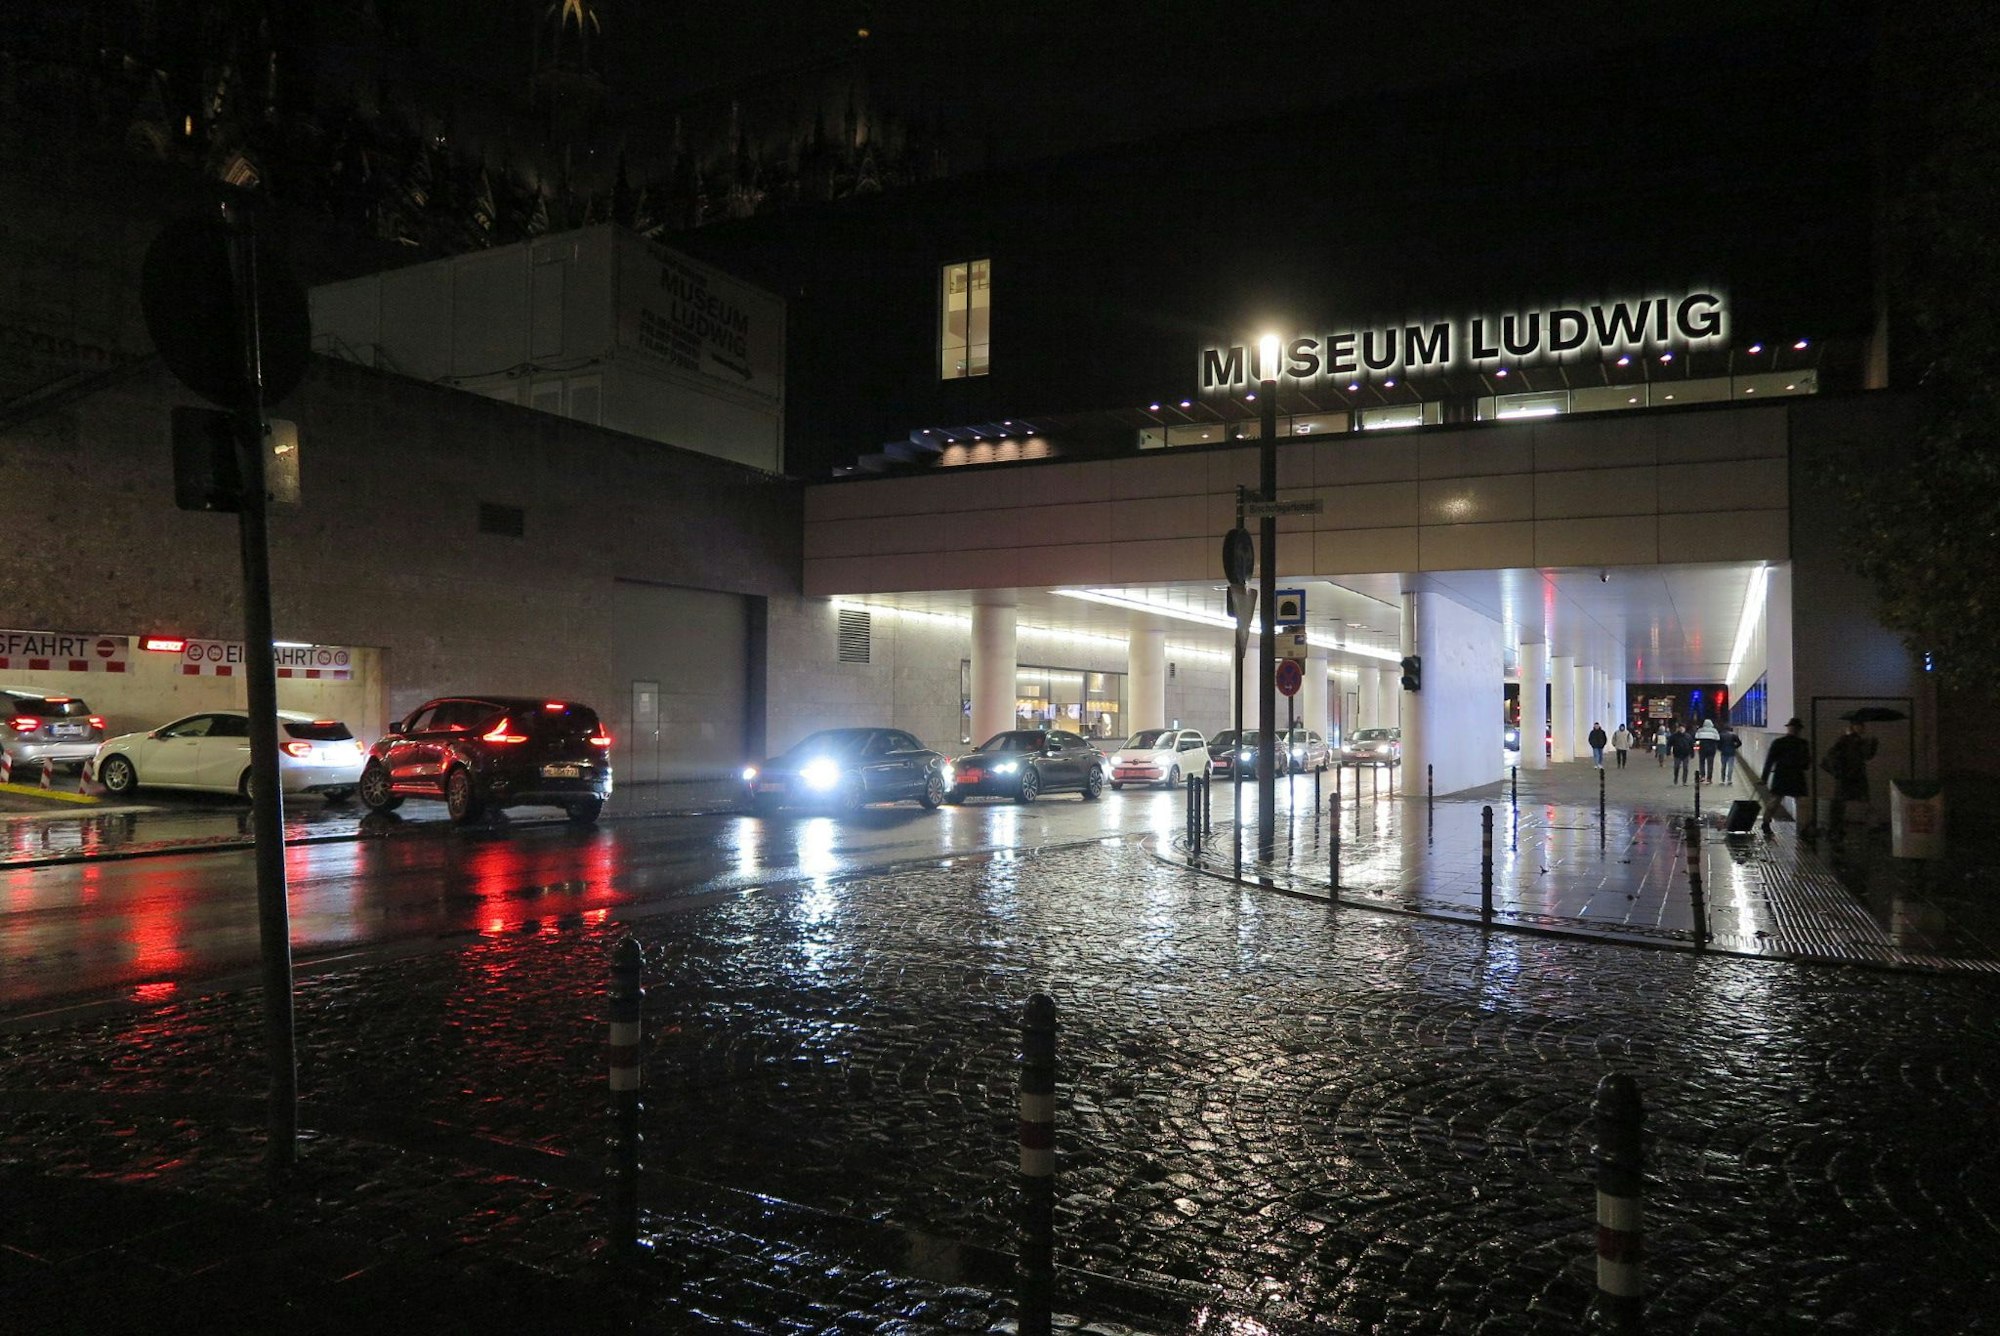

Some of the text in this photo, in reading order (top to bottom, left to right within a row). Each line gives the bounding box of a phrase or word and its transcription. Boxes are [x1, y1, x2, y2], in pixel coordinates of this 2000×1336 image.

[661, 268, 749, 335] MUSEUM
[671, 301, 747, 358] LUDWIG
[1471, 293, 1721, 359] LUDWIG
[227, 645, 316, 666] EIAHRT
